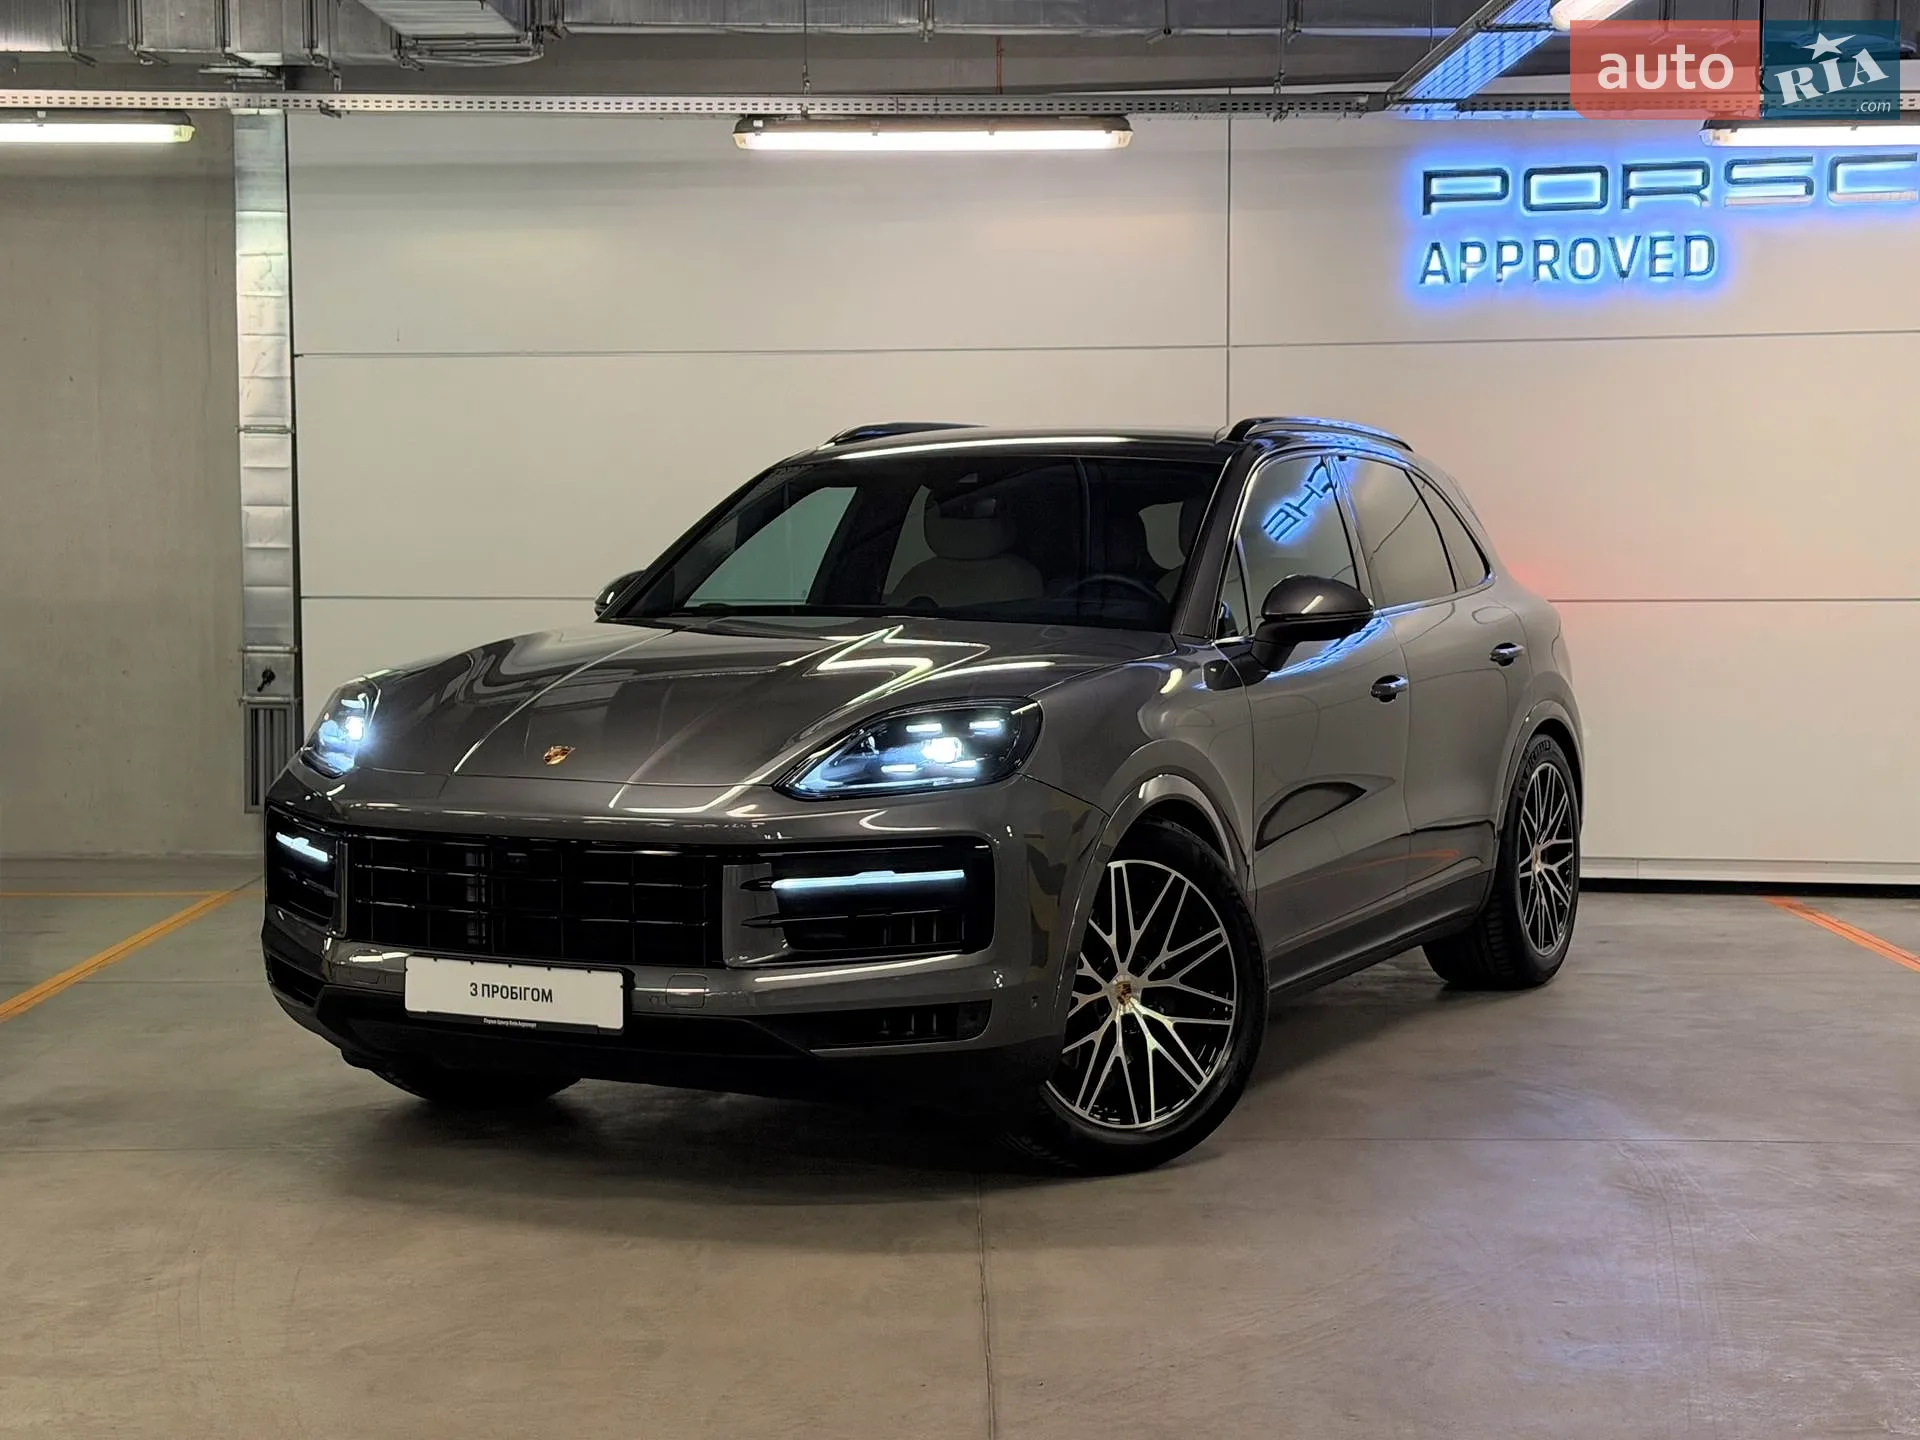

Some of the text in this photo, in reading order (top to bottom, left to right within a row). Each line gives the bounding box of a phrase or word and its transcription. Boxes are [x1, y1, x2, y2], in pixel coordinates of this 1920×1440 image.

[1422, 151, 1918, 216] PORSC
[1419, 234, 1716, 285] APPROVED
[481, 983, 553, 1003] ПРОБІГОМ
